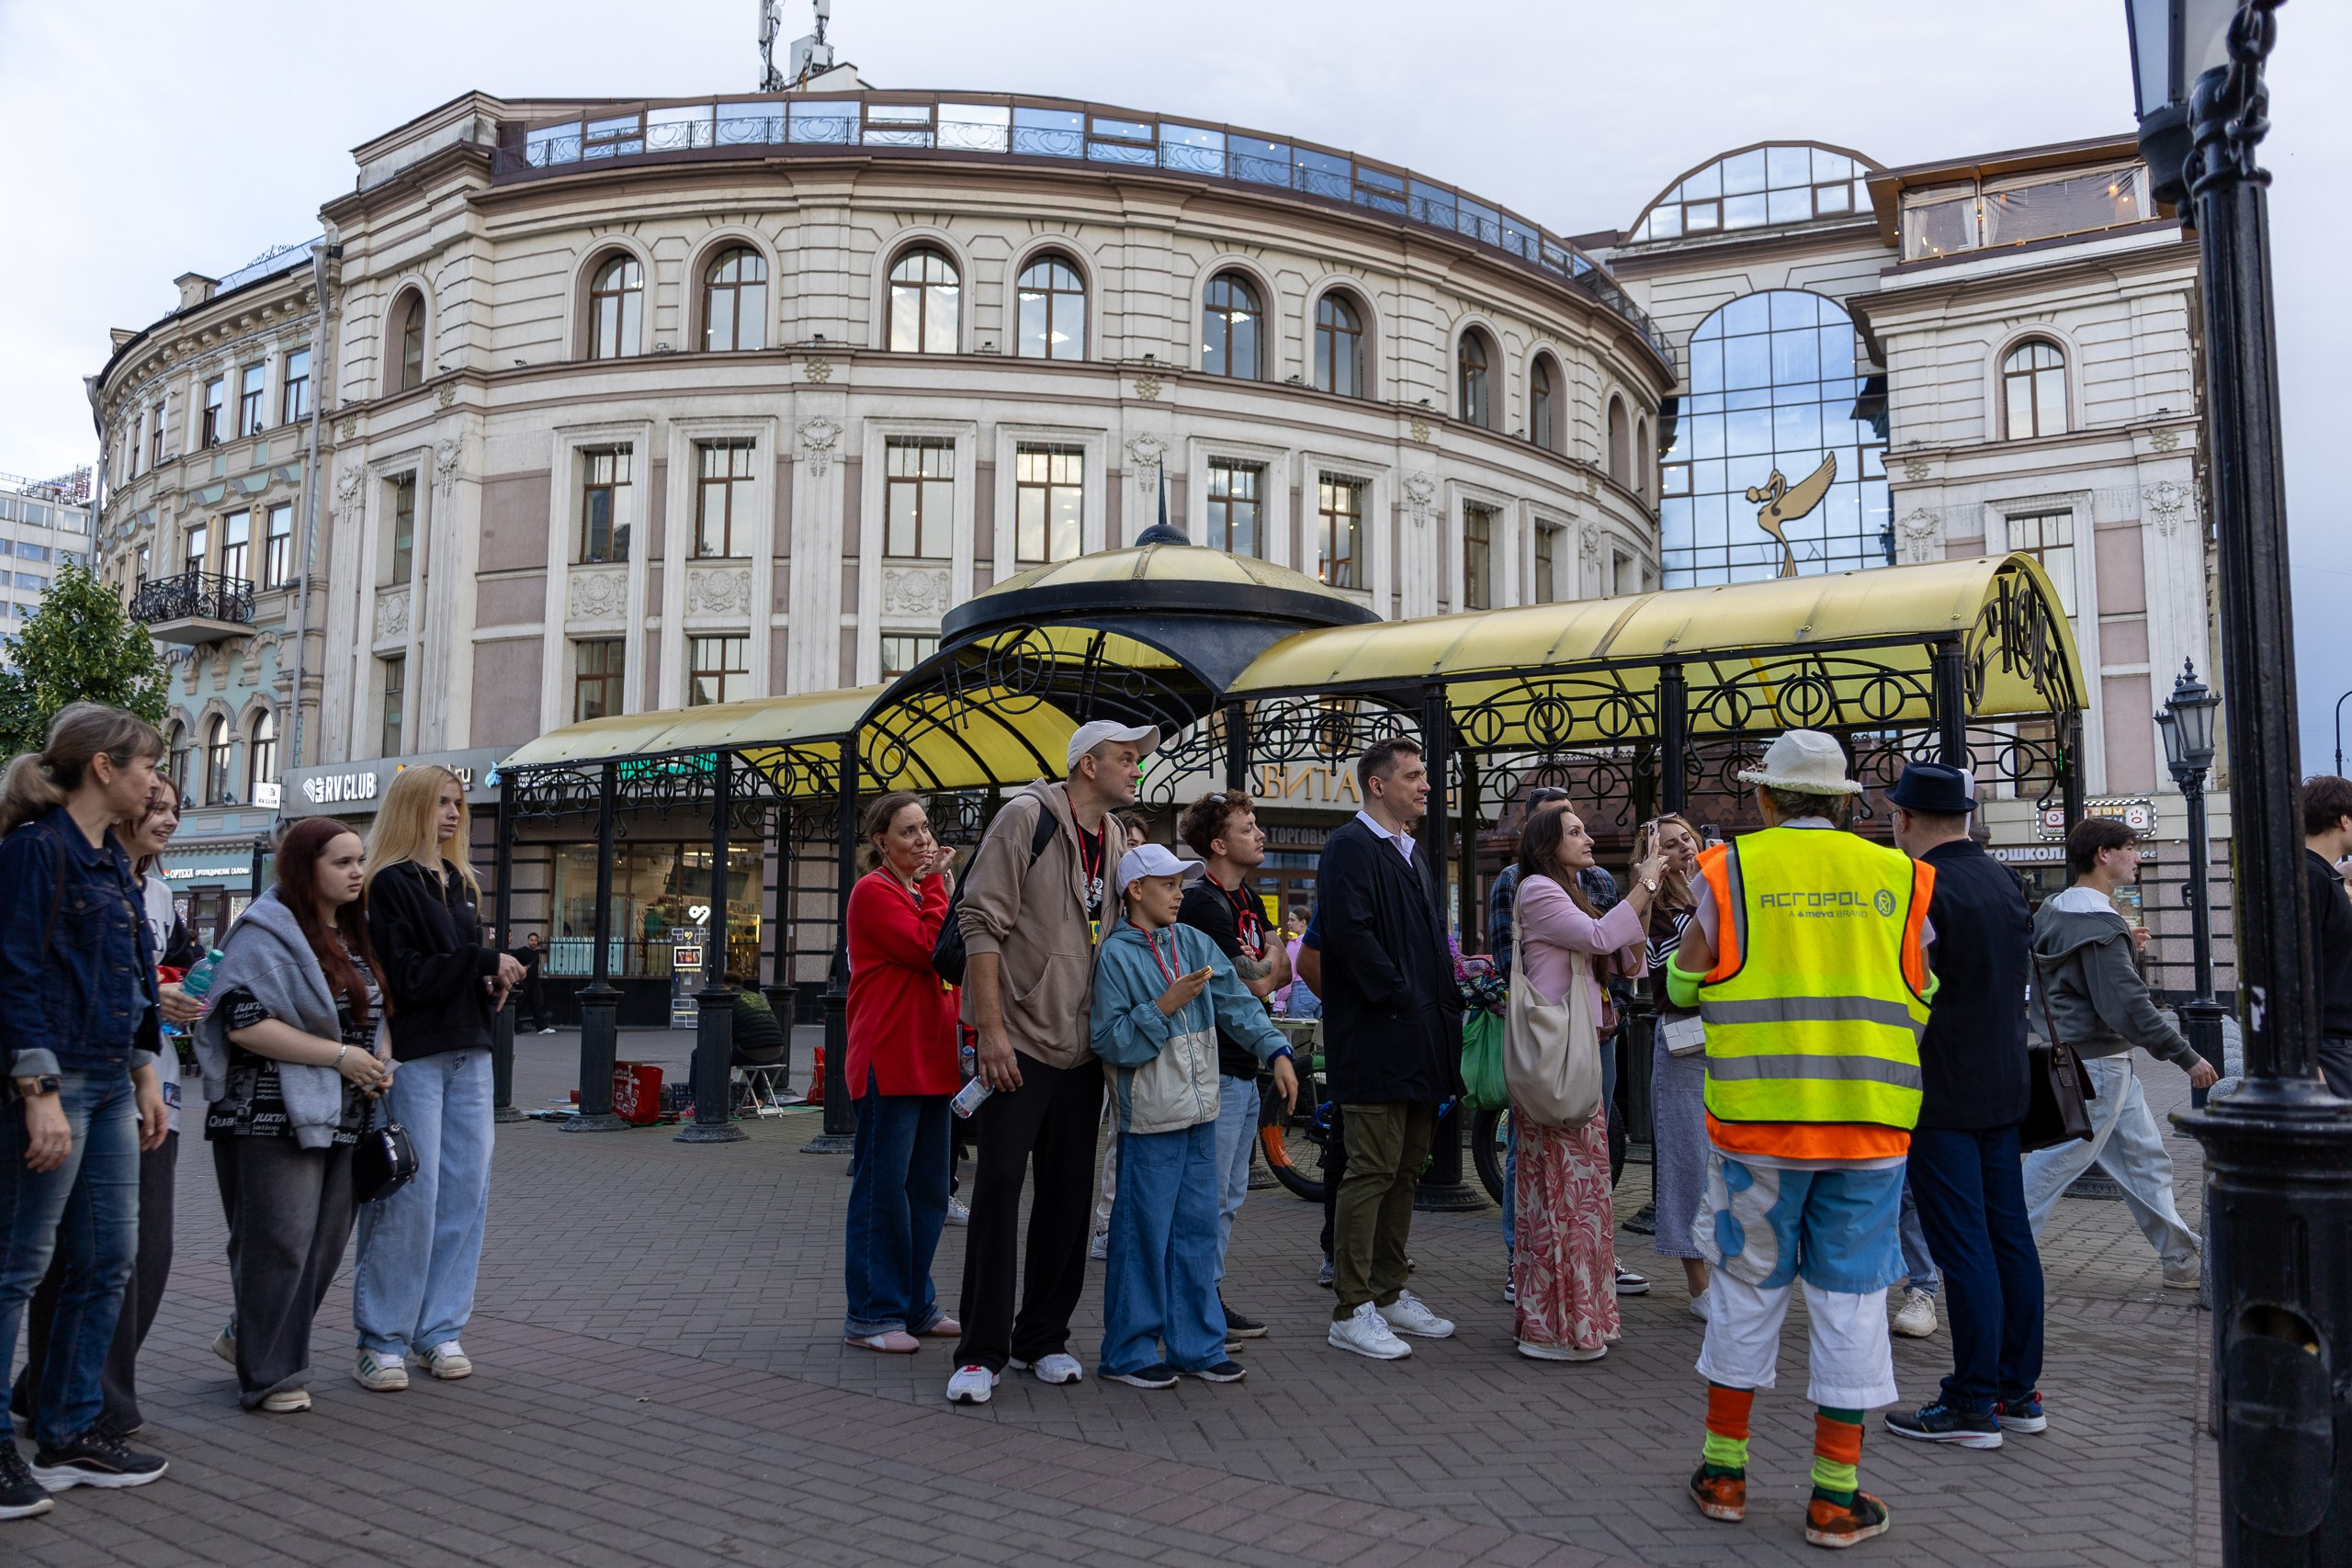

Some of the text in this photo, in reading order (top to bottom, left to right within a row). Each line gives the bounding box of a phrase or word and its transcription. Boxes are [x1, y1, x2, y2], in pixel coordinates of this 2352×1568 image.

[325, 773, 377, 802] RV CLUB
[1248, 765, 1360, 803] ВИТА
[1271, 827, 1339, 845] ТОРГОВЫ
